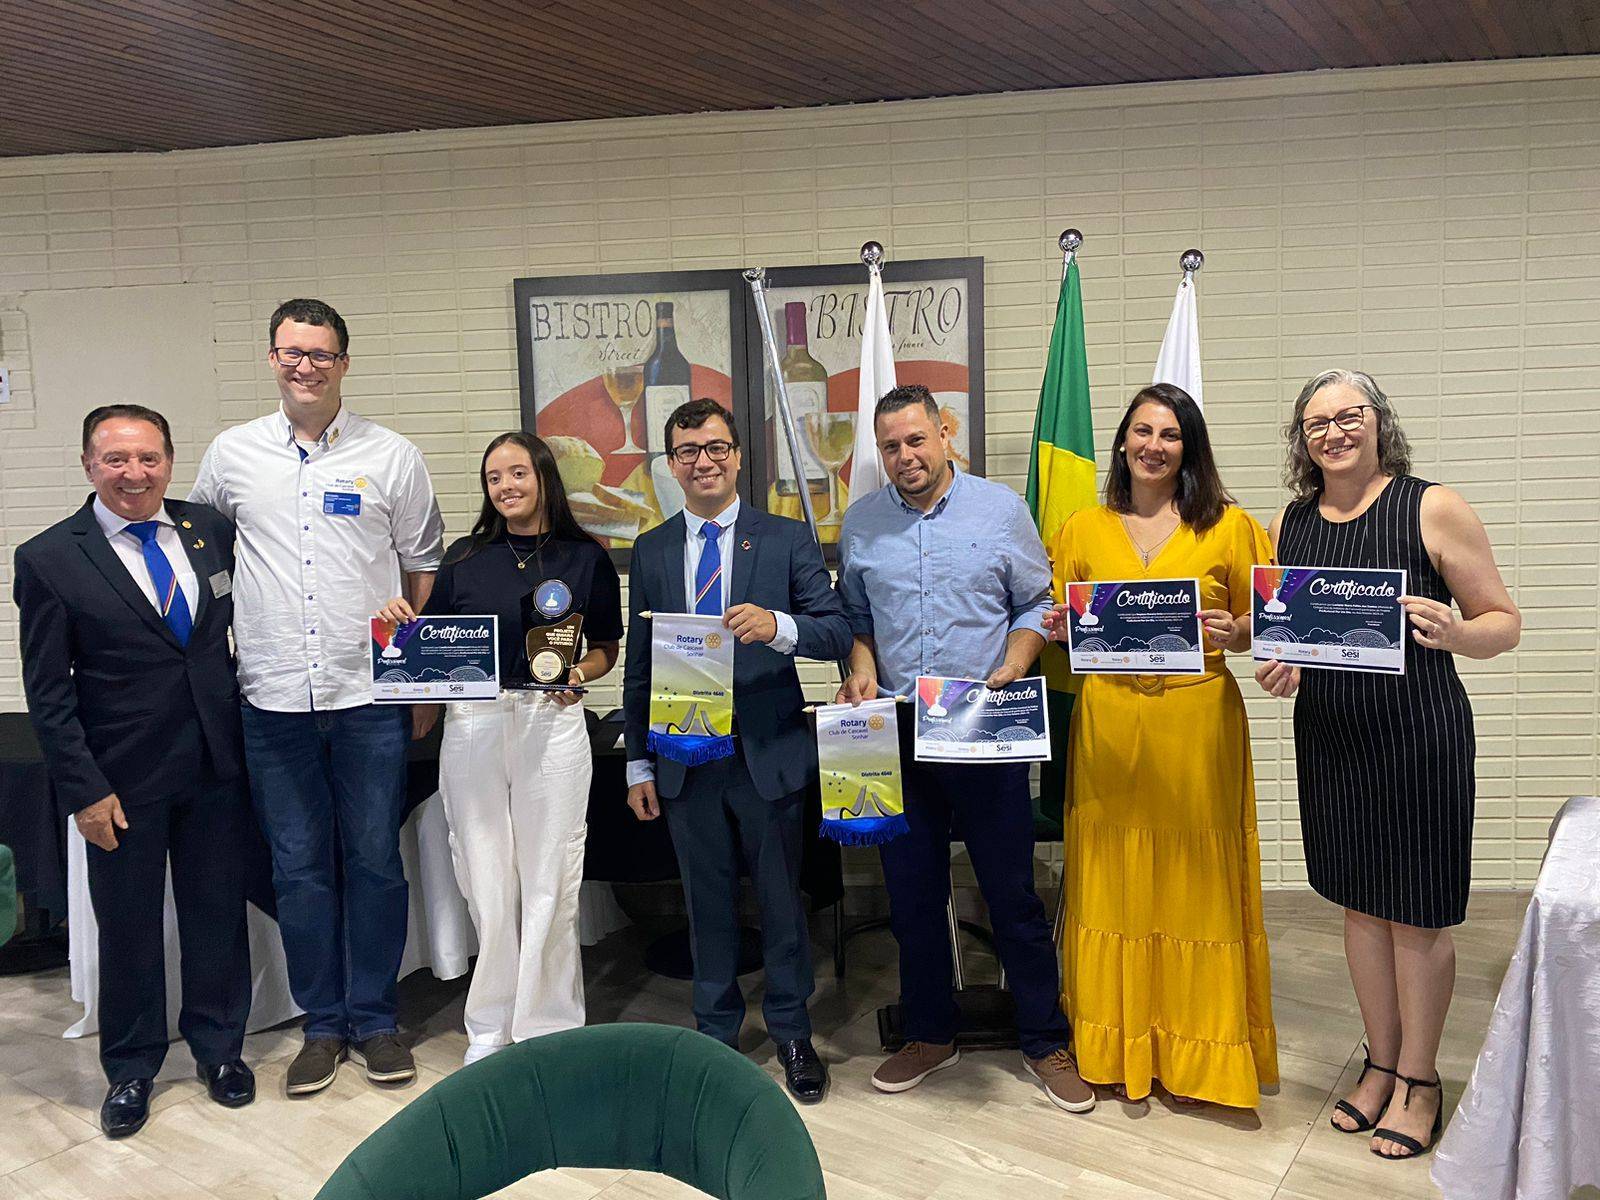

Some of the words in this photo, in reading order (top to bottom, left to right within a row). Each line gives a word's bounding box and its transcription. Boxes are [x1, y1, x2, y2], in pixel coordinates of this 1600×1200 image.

[531, 299, 653, 341] BISTRO
[1309, 577, 1396, 600] Certificado
[1116, 589, 1191, 610] Certificado
[419, 624, 490, 643] Certificado
[676, 634, 704, 645] Rotary
[1149, 654, 1166, 663] Sesi
[1341, 649, 1360, 658] Sesi
[449, 684, 464, 693] Sesi
[966, 686, 1038, 706] Ctificado
[840, 719, 867, 728] Rotary
[996, 743, 1013, 752] Sesi
